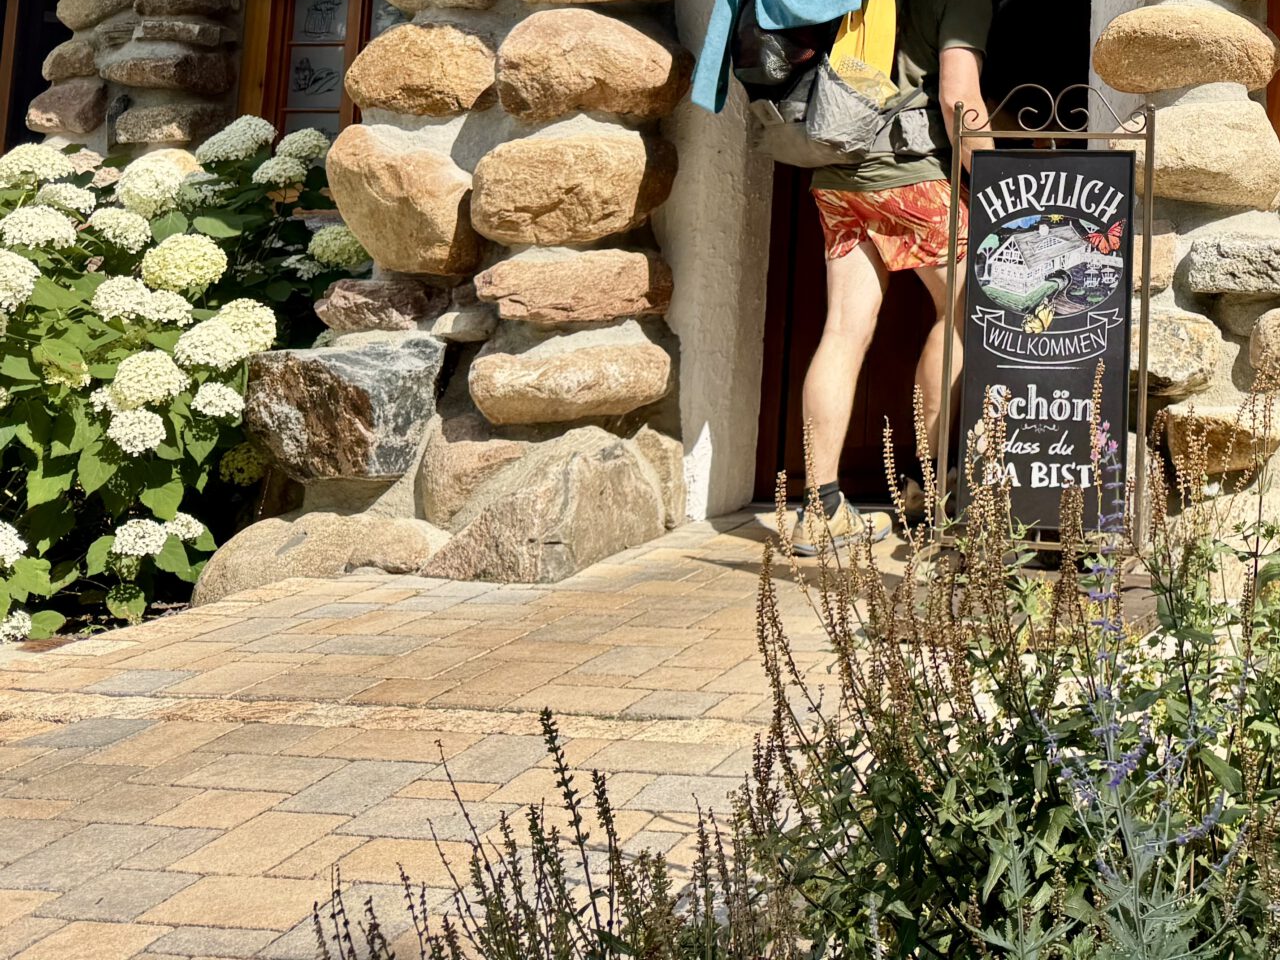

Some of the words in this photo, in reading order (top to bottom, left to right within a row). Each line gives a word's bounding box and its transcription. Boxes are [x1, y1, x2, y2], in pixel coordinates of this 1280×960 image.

[976, 171, 1125, 224] HERZLICH
[988, 326, 1106, 357] WILLKOMMEN
[988, 383, 1095, 422] Schön
[1003, 428, 1041, 454] dass
[1048, 430, 1075, 455] du
[1030, 461, 1095, 489] BIST
